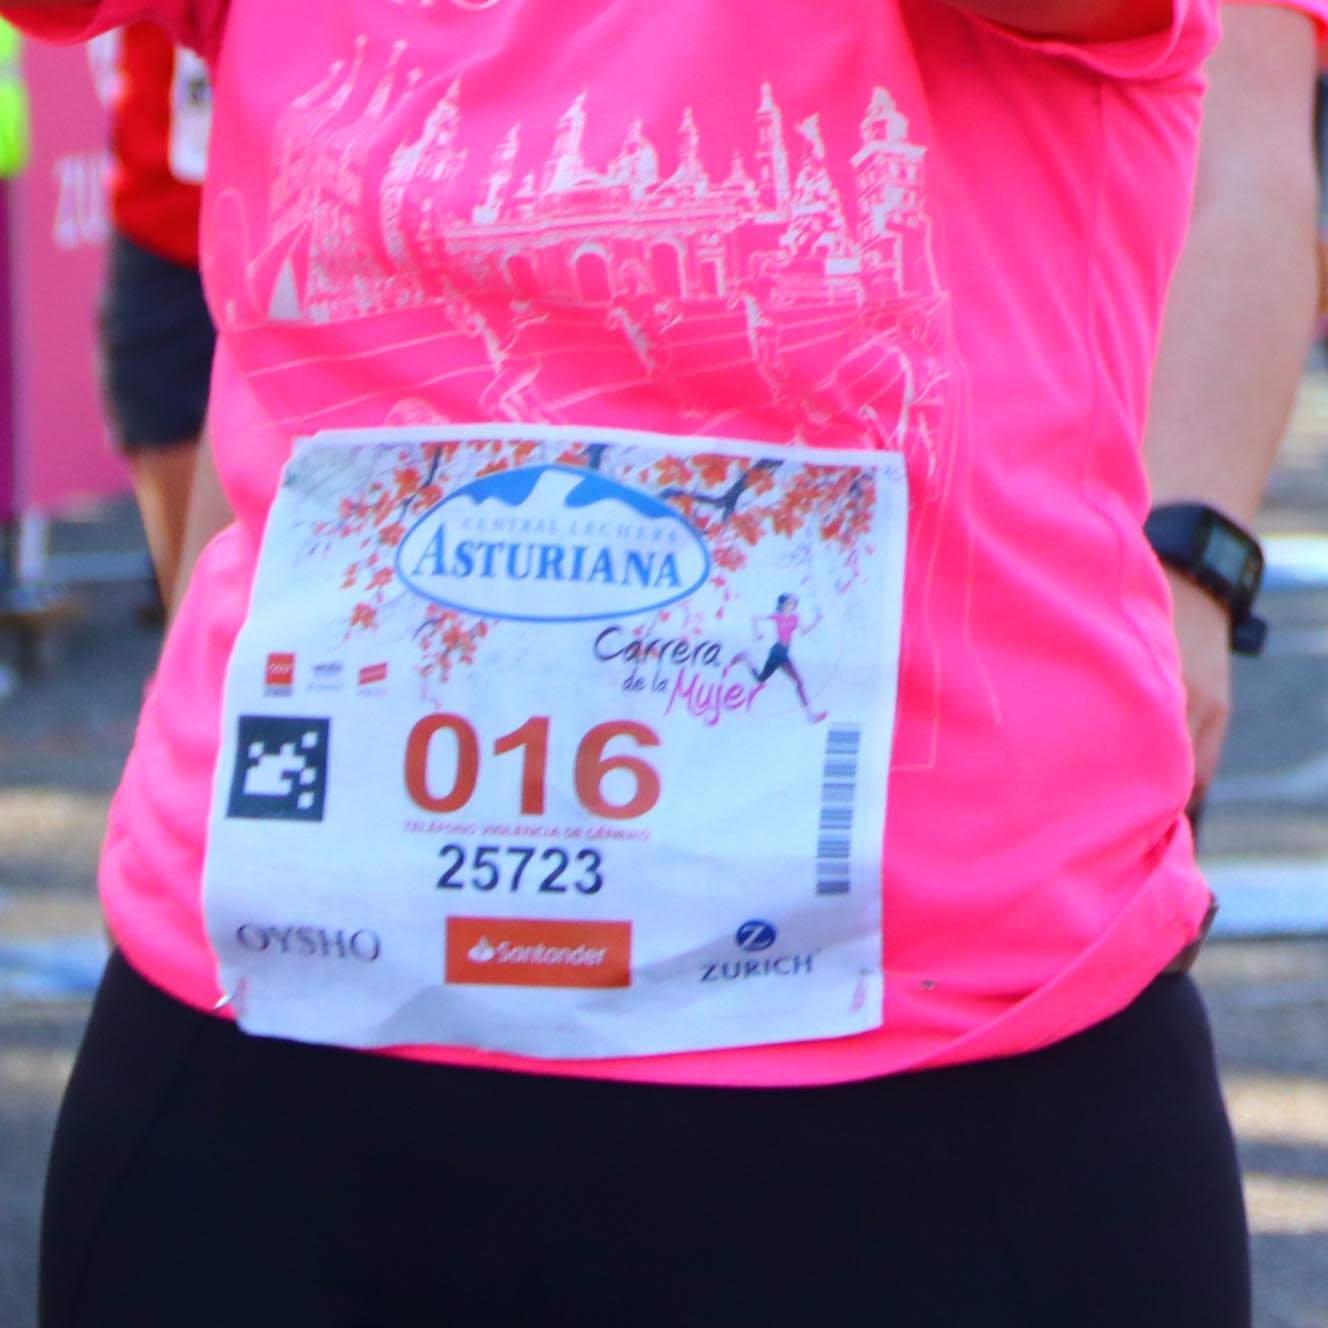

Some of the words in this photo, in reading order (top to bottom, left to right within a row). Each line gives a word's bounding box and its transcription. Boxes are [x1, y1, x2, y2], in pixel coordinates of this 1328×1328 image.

[462, 515, 560, 535] CENTRAL
[568, 519, 679, 542] LECHERA
[410, 521, 683, 588] ASTURIANA
[593, 625, 722, 666] Carrera
[623, 668, 646, 693] de
[652, 669, 669, 693] la
[663, 666, 768, 728] Mujer
[402, 711, 662, 821] 016
[435, 842, 605, 896] 25723
[235, 921, 382, 964] OYSHO
[494, 940, 609, 967] Santander
[699, 953, 813, 983] ZURICH
